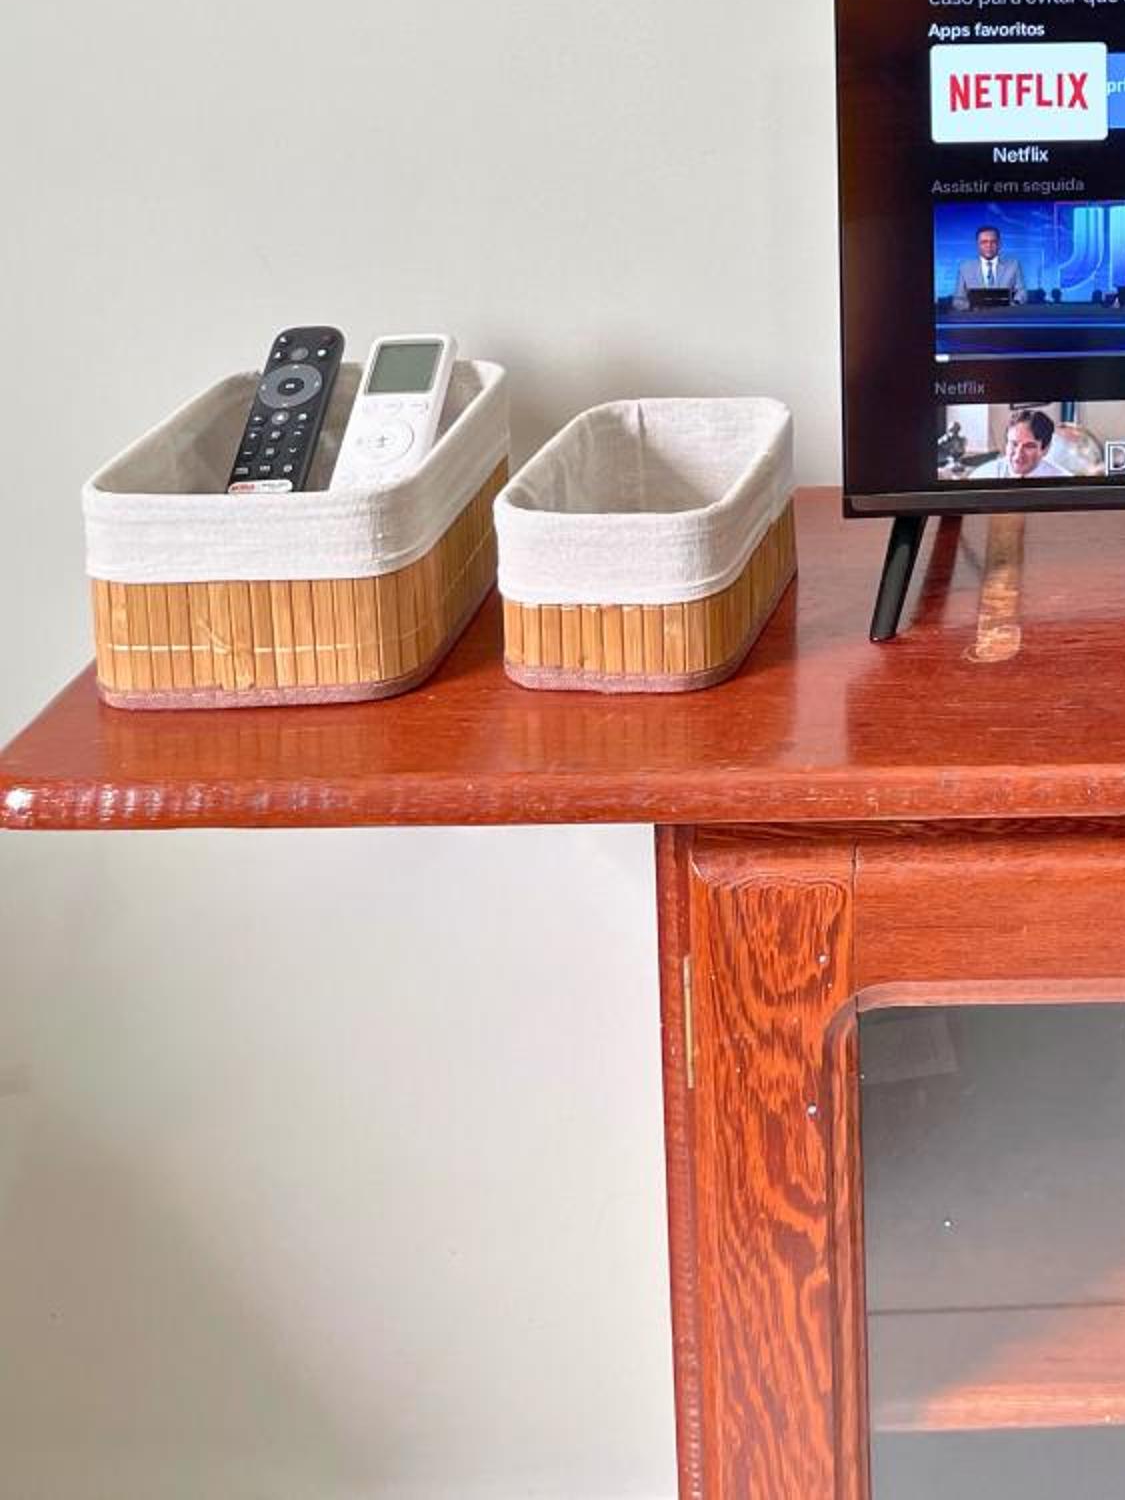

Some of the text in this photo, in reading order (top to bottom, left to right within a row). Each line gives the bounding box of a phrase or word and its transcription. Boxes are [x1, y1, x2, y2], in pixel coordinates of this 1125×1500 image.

[928, 22, 1045, 41] Apps favoritos
[949, 72, 1089, 112] NETFLIX
[992, 145, 1049, 163] Netflix
[931, 178, 1085, 195] Assistir em seguida
[934, 381, 985, 396] Netflix
